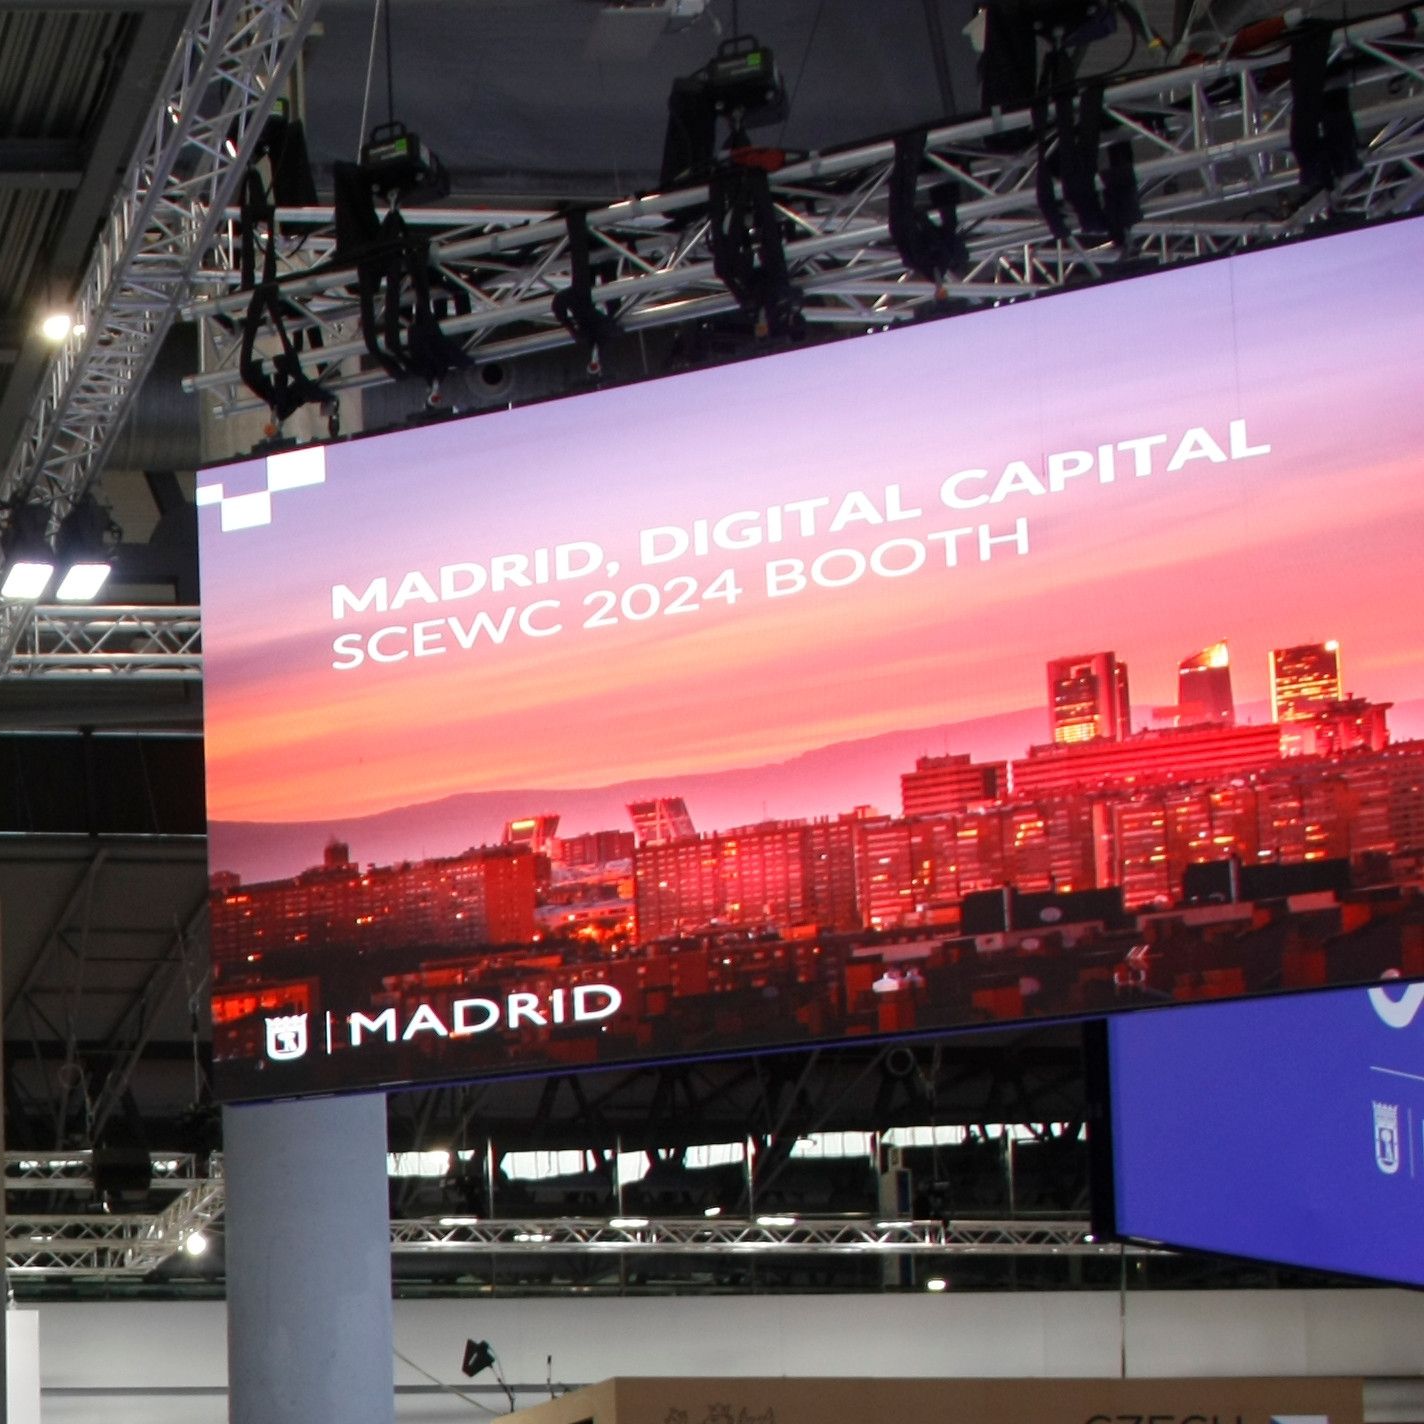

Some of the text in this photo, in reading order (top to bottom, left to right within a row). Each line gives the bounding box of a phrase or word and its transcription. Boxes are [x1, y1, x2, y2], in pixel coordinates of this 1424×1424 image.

[330, 418, 1272, 620] MADRID, DIGITAL CAPITAL
[330, 517, 1030, 672] SCEWC 2024 BOOTH
[349, 983, 623, 1047] MADRID
